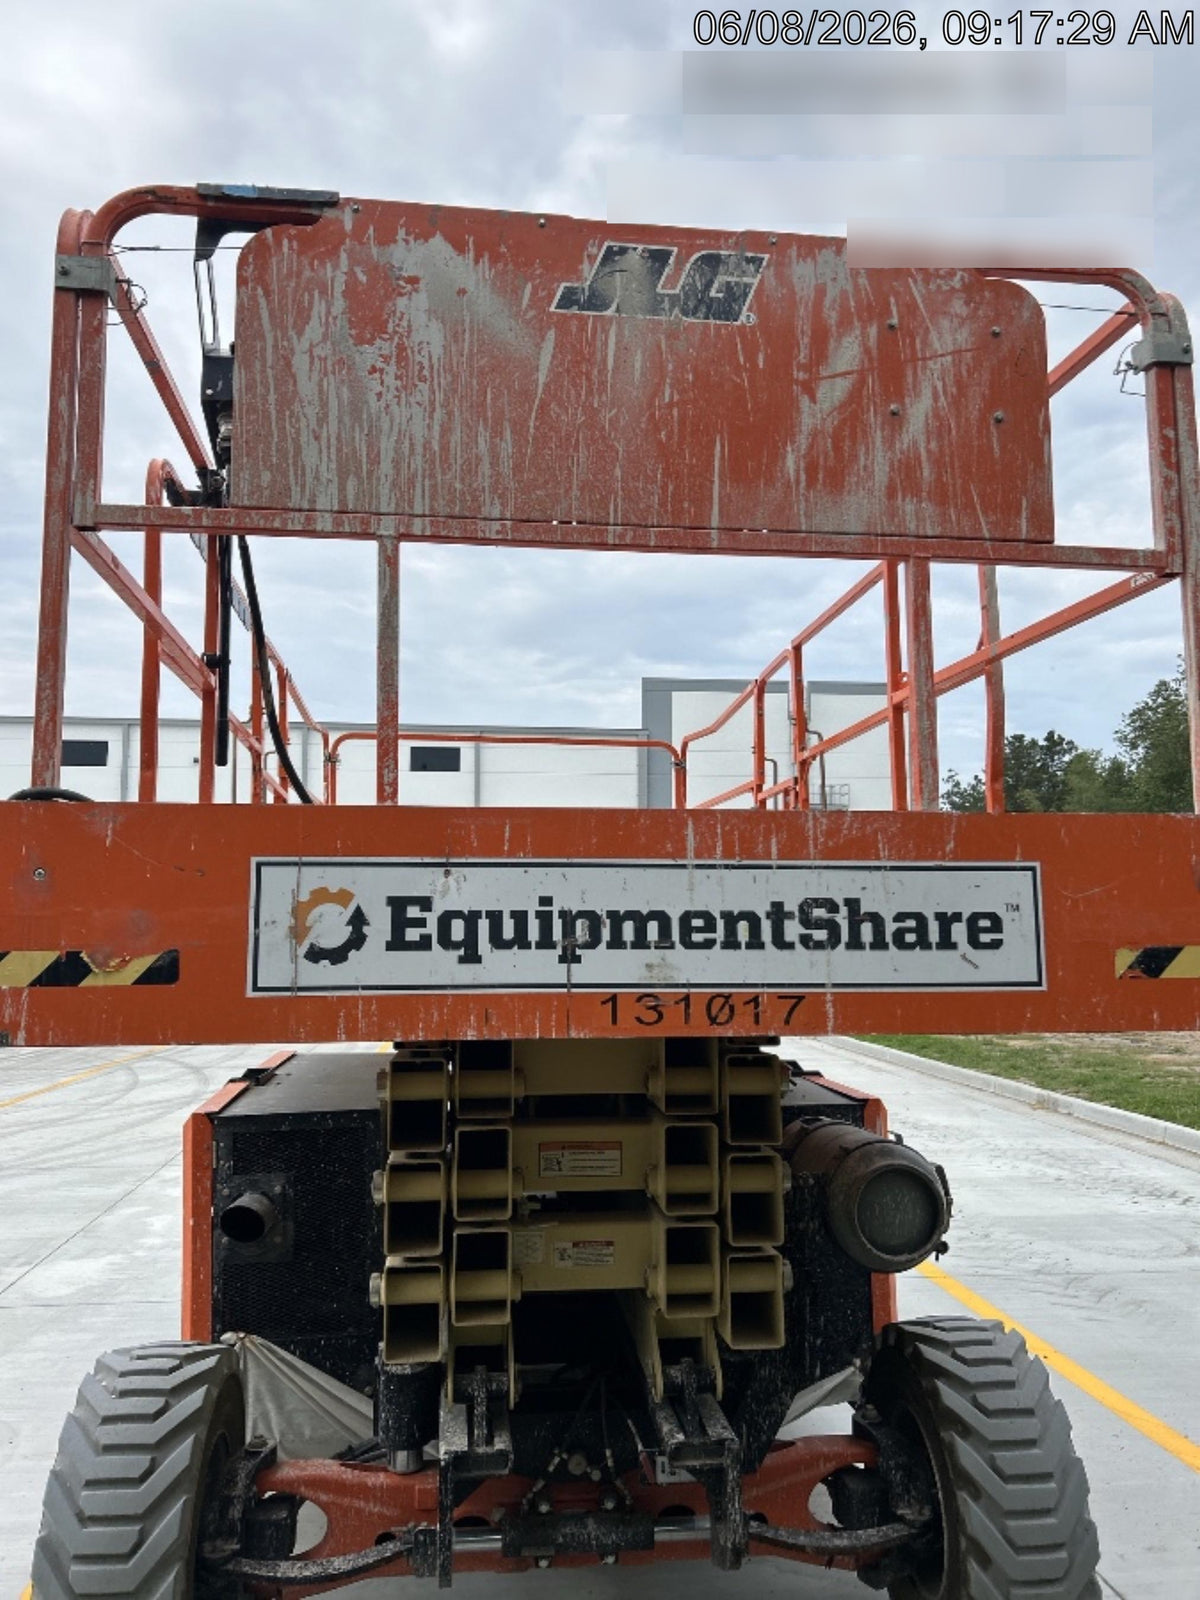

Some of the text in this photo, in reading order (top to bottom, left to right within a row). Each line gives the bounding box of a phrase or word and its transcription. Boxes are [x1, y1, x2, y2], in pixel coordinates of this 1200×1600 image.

[550, 240, 769, 325] JLG
[385, 895, 1004, 966] EquipmentShare
[600, 992, 807, 1027] 131017
